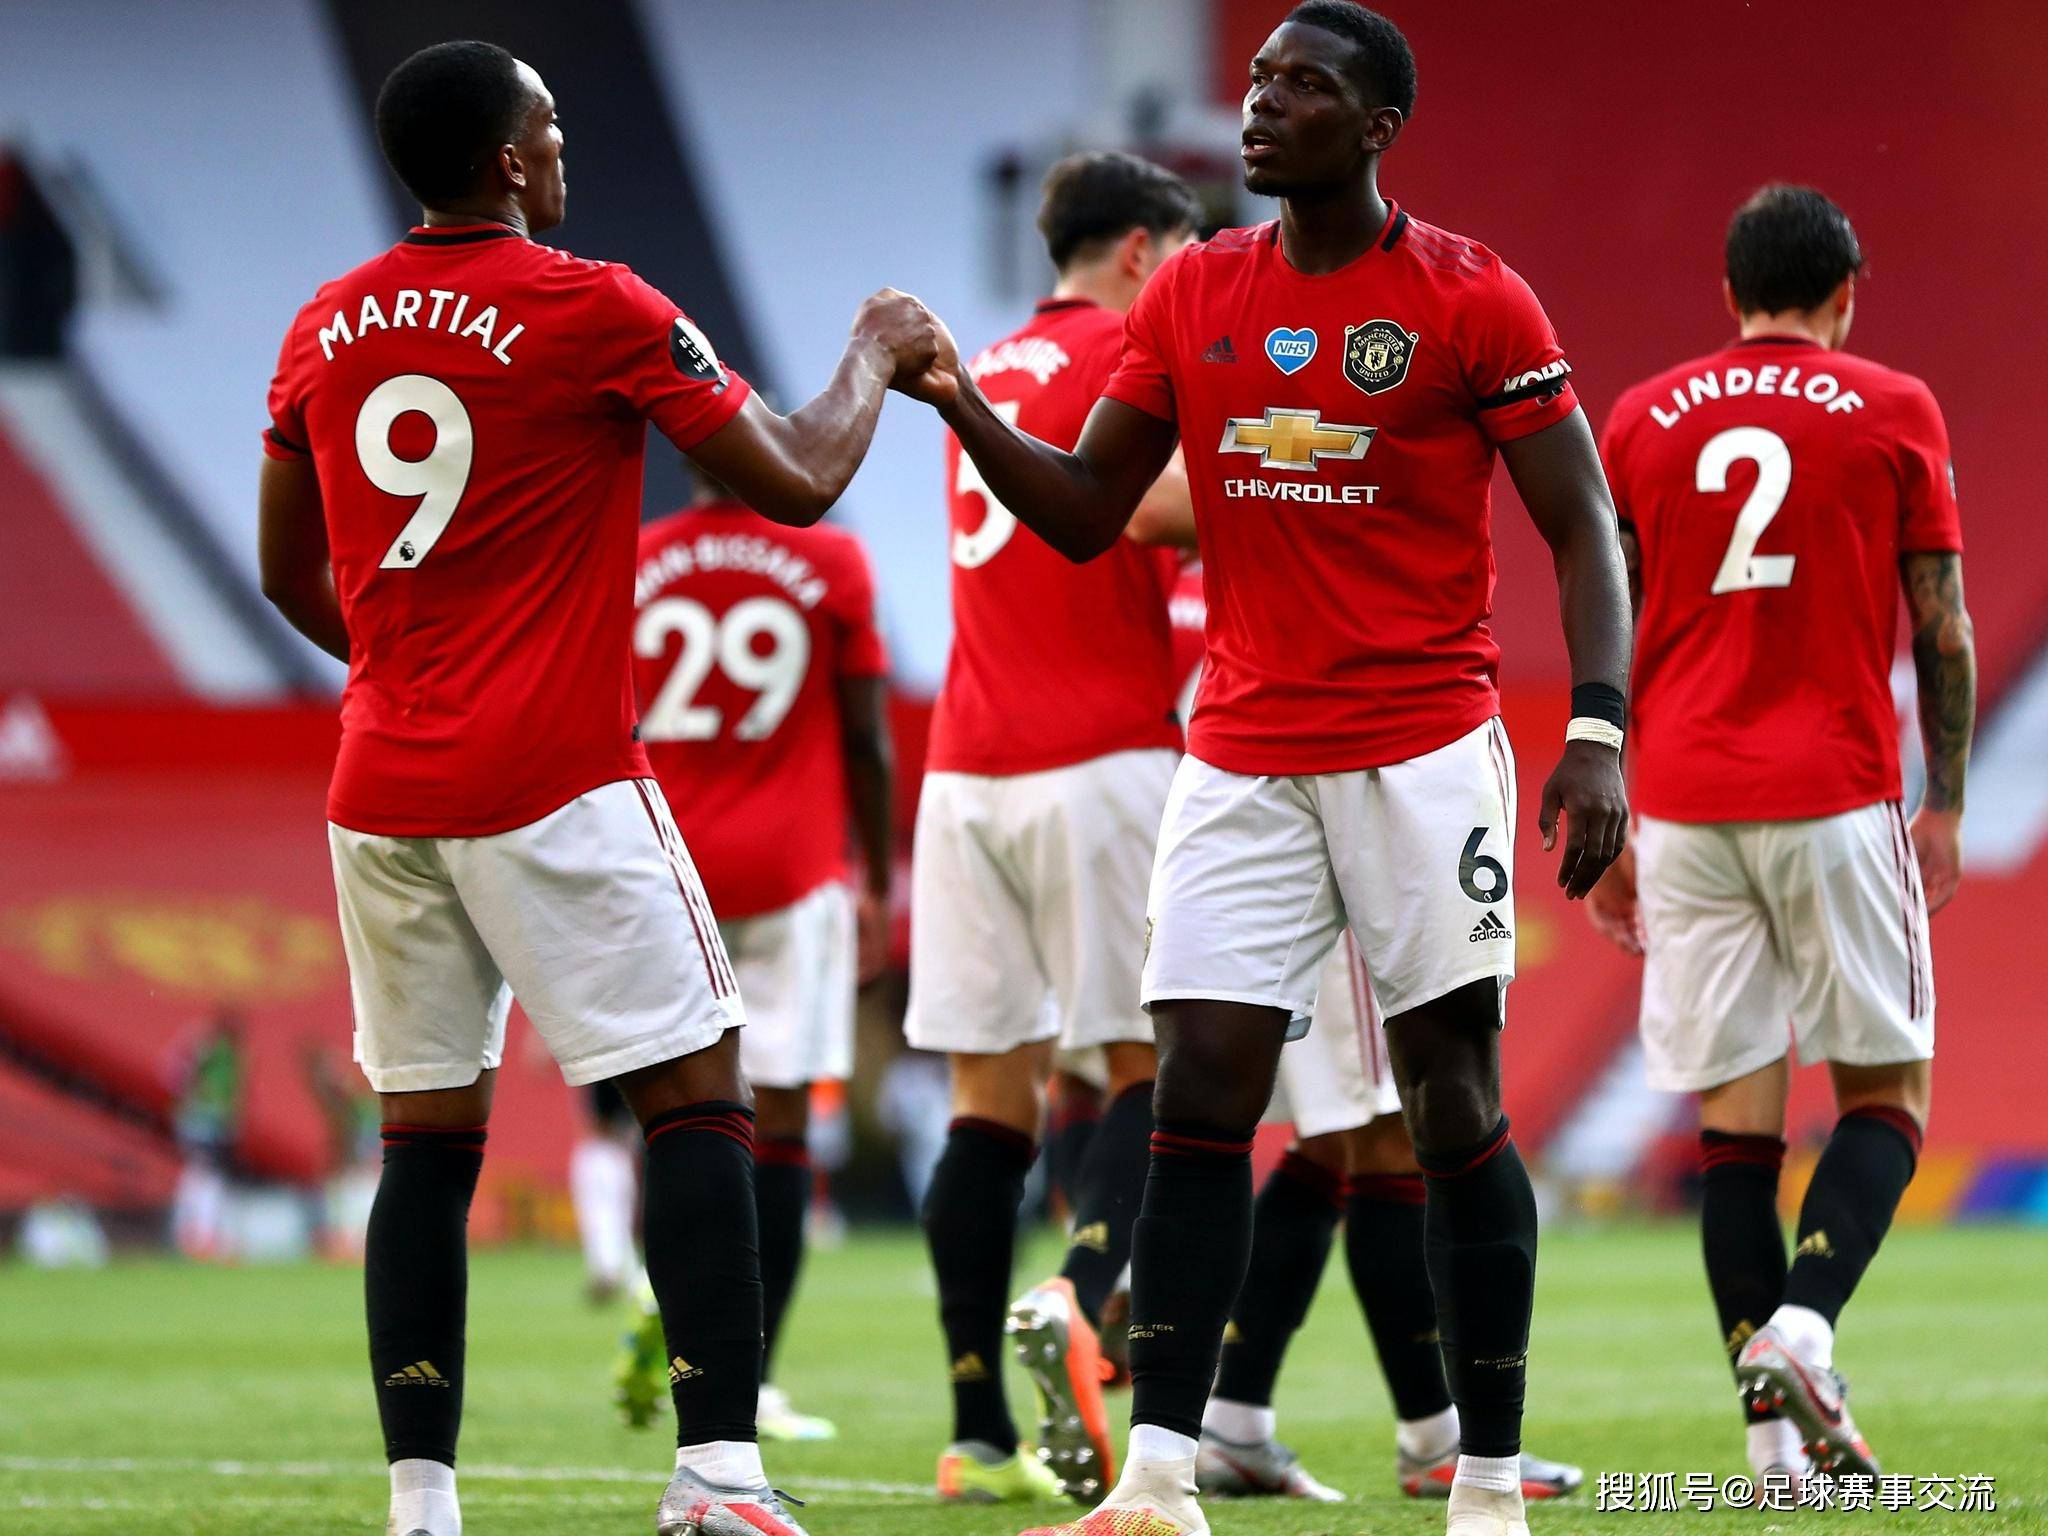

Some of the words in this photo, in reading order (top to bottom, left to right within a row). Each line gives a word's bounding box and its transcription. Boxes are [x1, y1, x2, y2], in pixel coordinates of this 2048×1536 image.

[318, 289, 525, 365] MARTIAL
[1275, 342, 1308, 355] NHS
[1358, 332, 1401, 352] MANCHESTER
[1360, 368, 1389, 379] UNITED
[1650, 365, 1864, 429] LINDELOF
[355, 374, 473, 569] 9
[1225, 479, 1380, 504] CHEVROLET
[1696, 426, 1796, 595] 2
[633, 596, 812, 741] 29
[1458, 826, 1508, 904] 6
[1469, 928, 1512, 943] adidas
